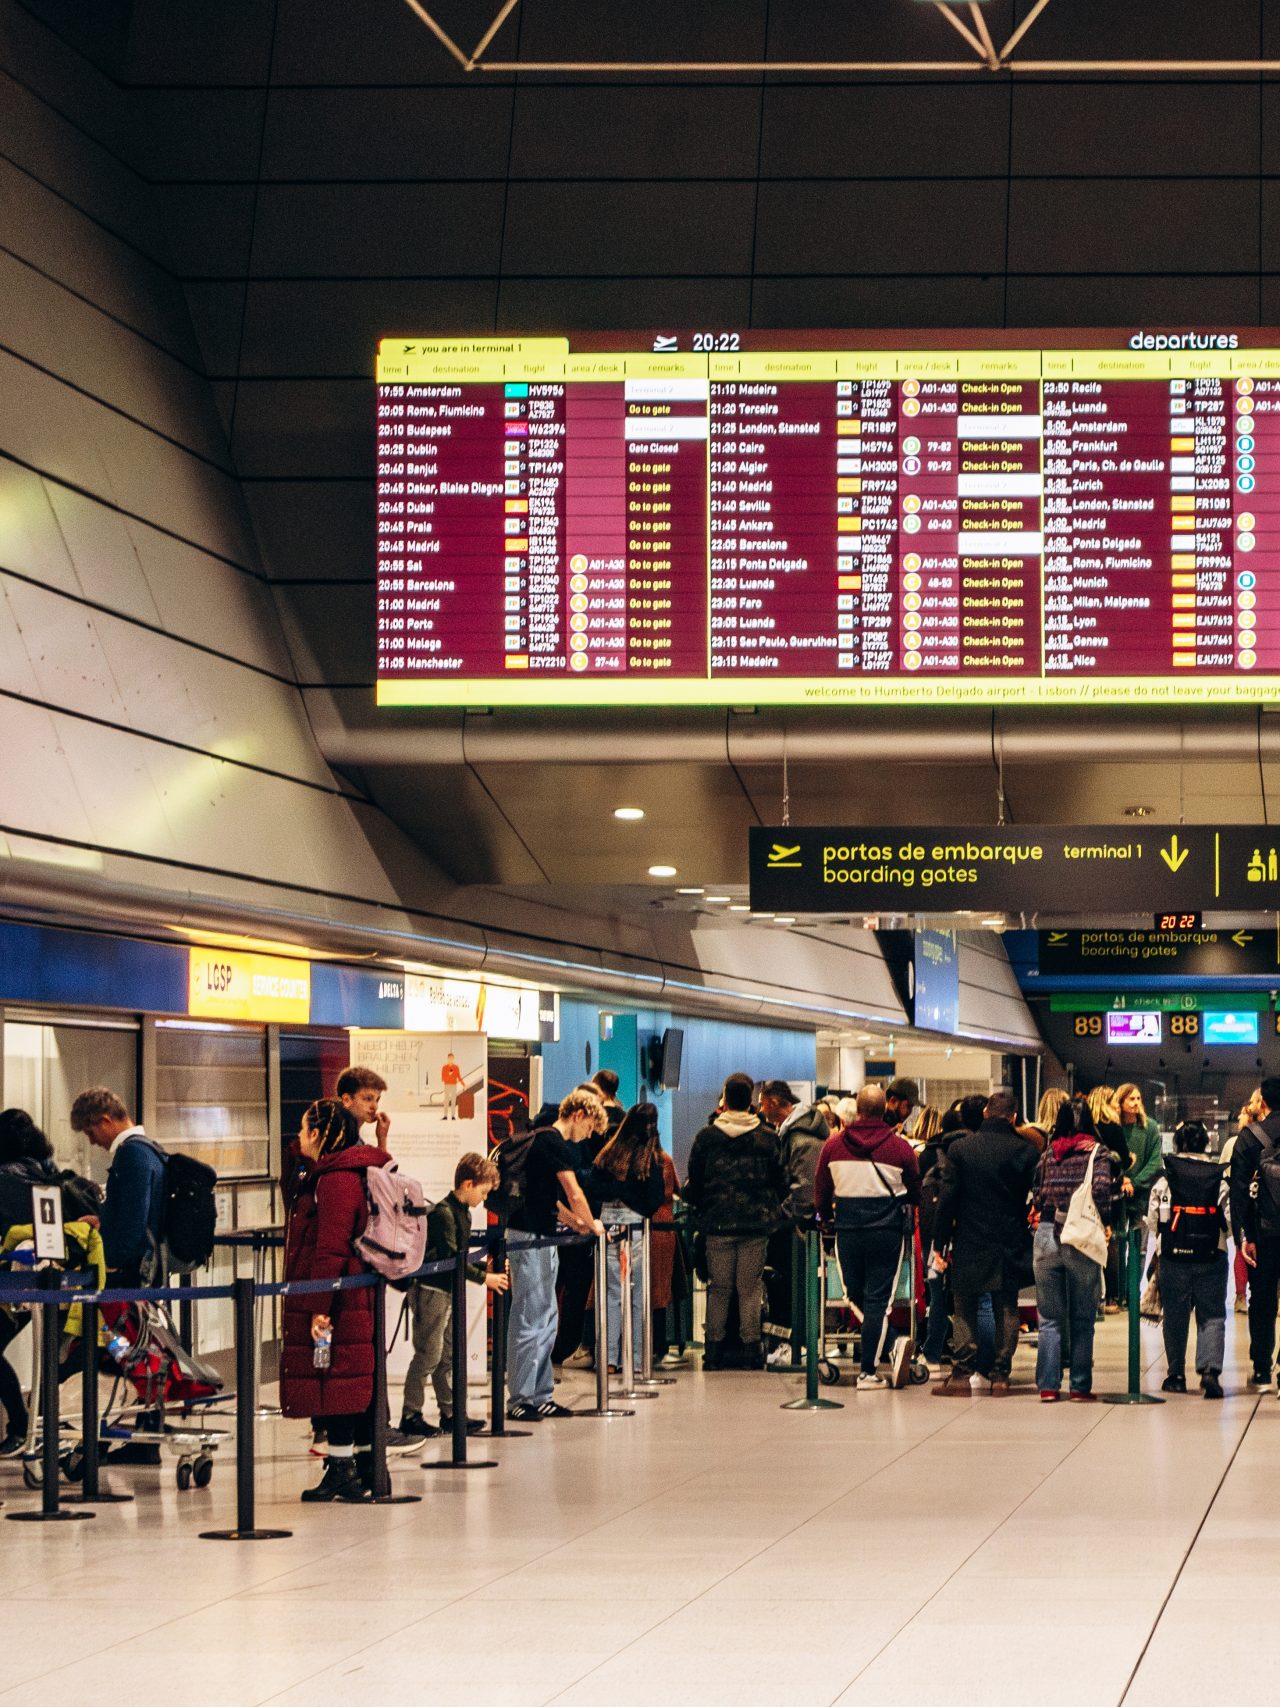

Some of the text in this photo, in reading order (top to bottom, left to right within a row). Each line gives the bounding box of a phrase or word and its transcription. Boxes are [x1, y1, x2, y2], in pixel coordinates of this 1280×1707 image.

[693, 333, 740, 351] 20:22
[1130, 331, 1241, 350] departures
[422, 347, 438, 355] you
[473, 344, 513, 352] terminal
[519, 344, 521, 352] 1
[433, 365, 480, 373] destination
[649, 364, 684, 372] remarks
[379, 386, 404, 397] 19:55
[406, 386, 461, 397] Amsterdam
[711, 384, 736, 395] 21:10
[739, 384, 777, 395] Madeira
[962, 383, 999, 393] Check-in
[1000, 383, 1022, 394] Open
[1072, 382, 1102, 394] Recife
[378, 404, 670, 418] 20:05 Rome, Fiumicino Go to gate
[378, 424, 451, 438] 20:10 Budapest
[710, 422, 820, 434] 21:25 London, Stansted
[1071, 421, 1127, 434] Amsterdam
[378, 443, 678, 456] 20:25 Dublin Gate Closed
[739, 442, 764, 454] Cairo
[1071, 440, 1117, 453] Frankfurt
[407, 463, 438, 477] Banjul
[1071, 479, 1103, 492] Zurich
[1073, 577, 1108, 588] Munich
[379, 618, 433, 630] 21:00 Porto
[379, 657, 404, 669] 21:05
[407, 657, 463, 669] Manchester
[805, 687, 856, 696] welcome
[860, 688, 870, 696] to
[875, 687, 932, 696] Humberto
[936, 686, 983, 698] Delgado
[987, 687, 1025, 698] airport
[1038, 686, 1076, 696] Lisbon
[1093, 686, 1130, 697] please
[1134, 686, 1147, 695] do
[1152, 687, 1169, 695] not
[1174, 686, 1203, 695] leave
[1207, 687, 1231, 697] your
[824, 842, 1142, 866] portas de embarque terminal 1
[824, 864, 978, 887] boarding gates
[1081, 932, 1218, 947] portas de embarque
[1082, 945, 1177, 958] boarding gates
[207, 962, 232, 992] LGSP
[1074, 1016, 1102, 1035] 89
[1171, 1016, 1198, 1034] 88
